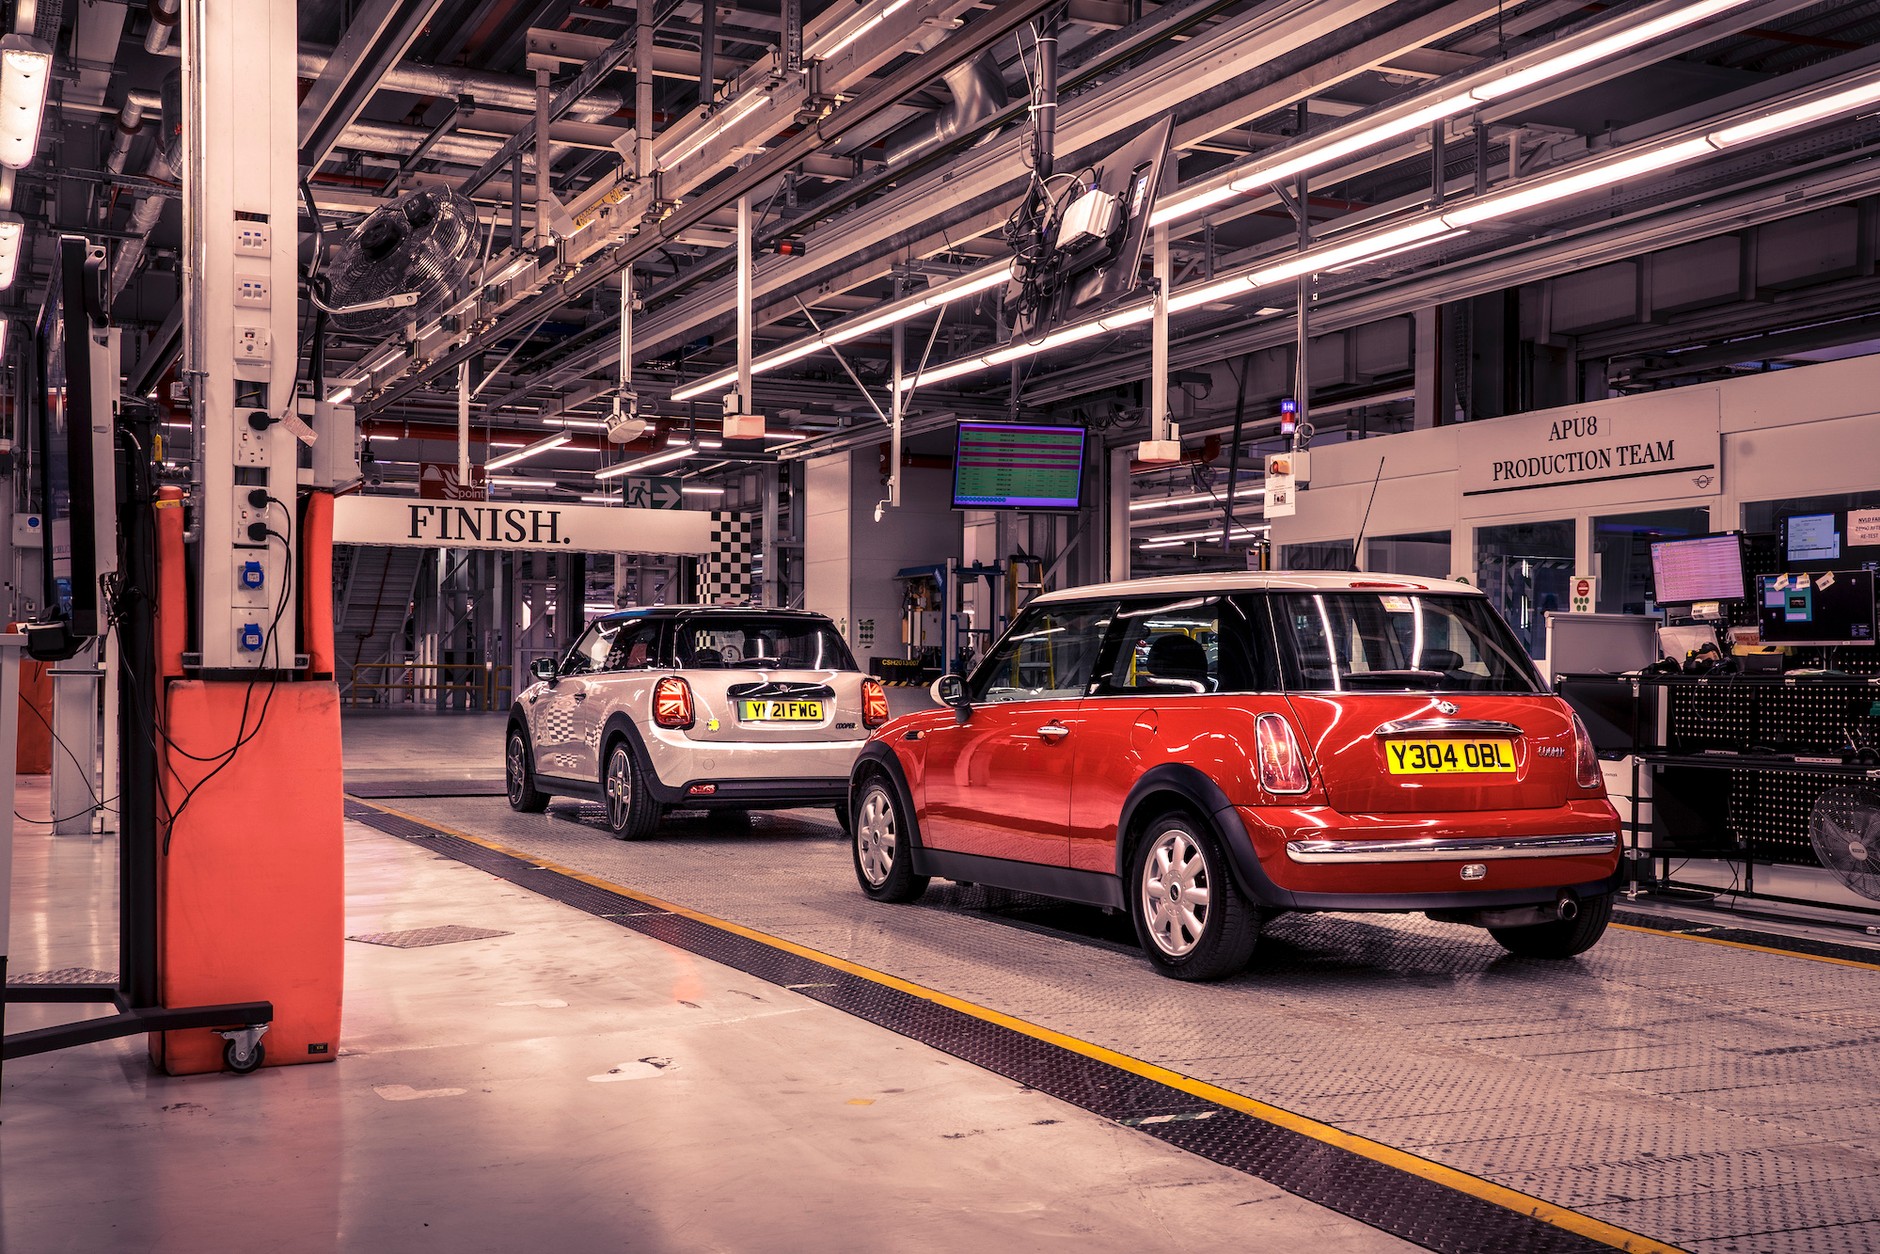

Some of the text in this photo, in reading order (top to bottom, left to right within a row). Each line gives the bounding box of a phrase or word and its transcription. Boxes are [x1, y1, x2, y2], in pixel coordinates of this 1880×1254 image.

[1548, 416, 1598, 441] APU8
[1492, 440, 1675, 481] PRODUCTION TEAM
[458, 488, 486, 500] point
[407, 504, 571, 545] FINISH.
[727, 649, 733, 659] 5
[789, 703, 818, 717] FWG
[1391, 744, 1459, 770] Y304
[1465, 743, 1511, 768] OBL
